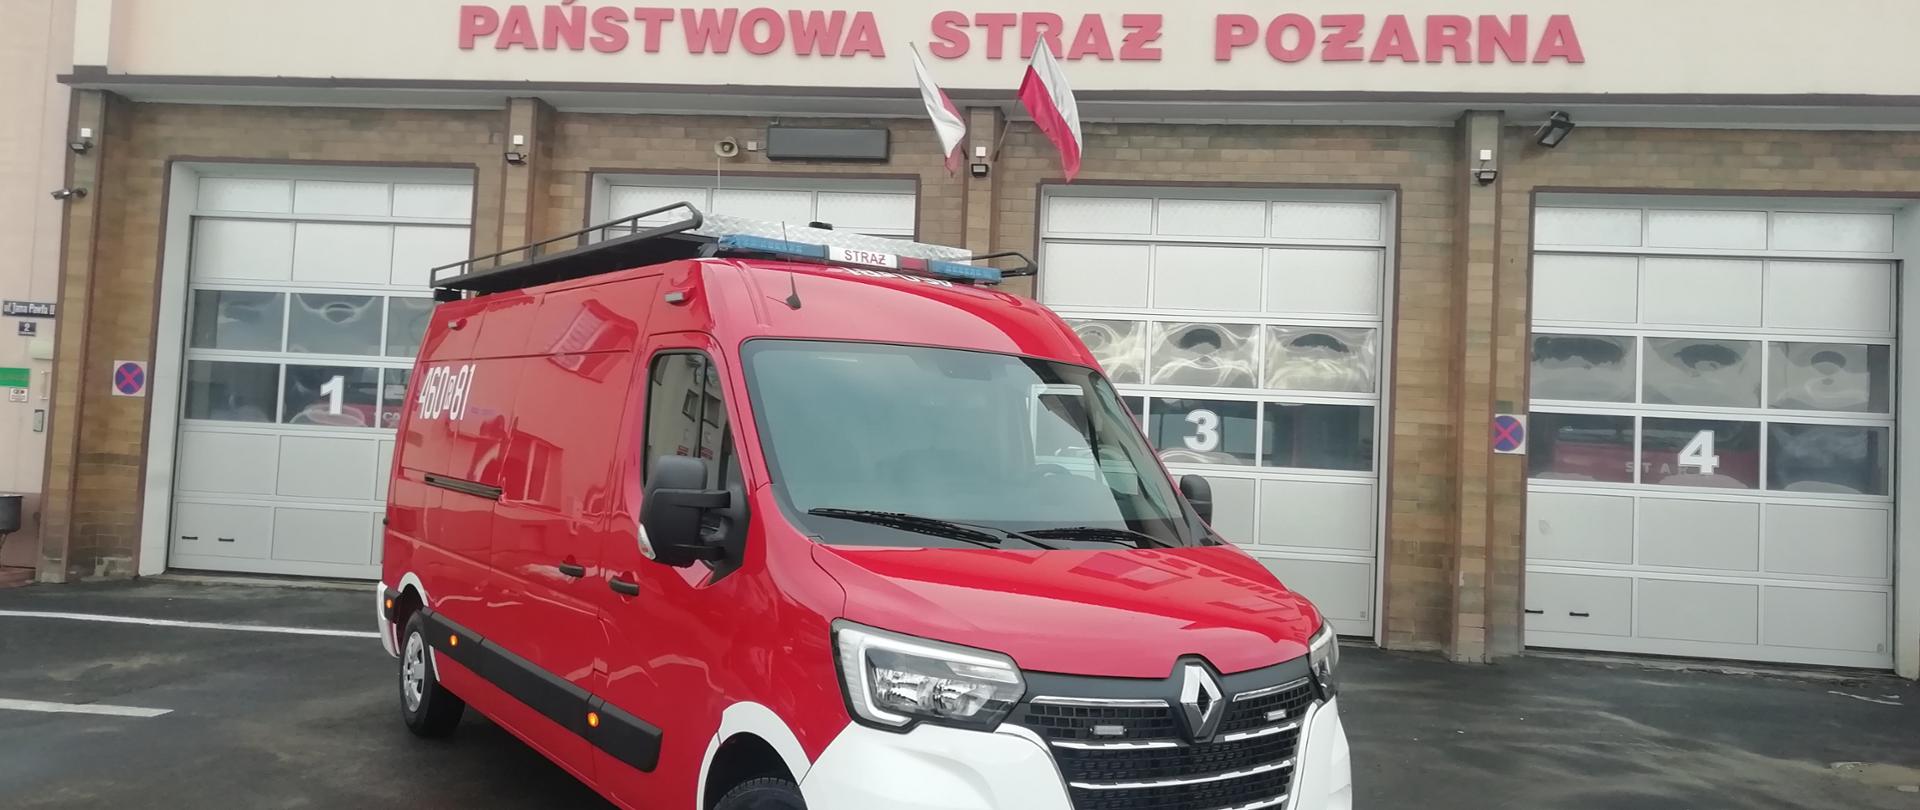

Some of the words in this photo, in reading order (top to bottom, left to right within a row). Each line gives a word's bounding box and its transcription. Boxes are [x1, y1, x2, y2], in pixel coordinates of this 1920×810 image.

[460, 0, 884, 58] PAŃSTWOWA
[24, 322, 31, 332] 2
[320, 375, 344, 415] 1
[1183, 408, 1220, 452] 3
[1678, 429, 1720, 476] 4
